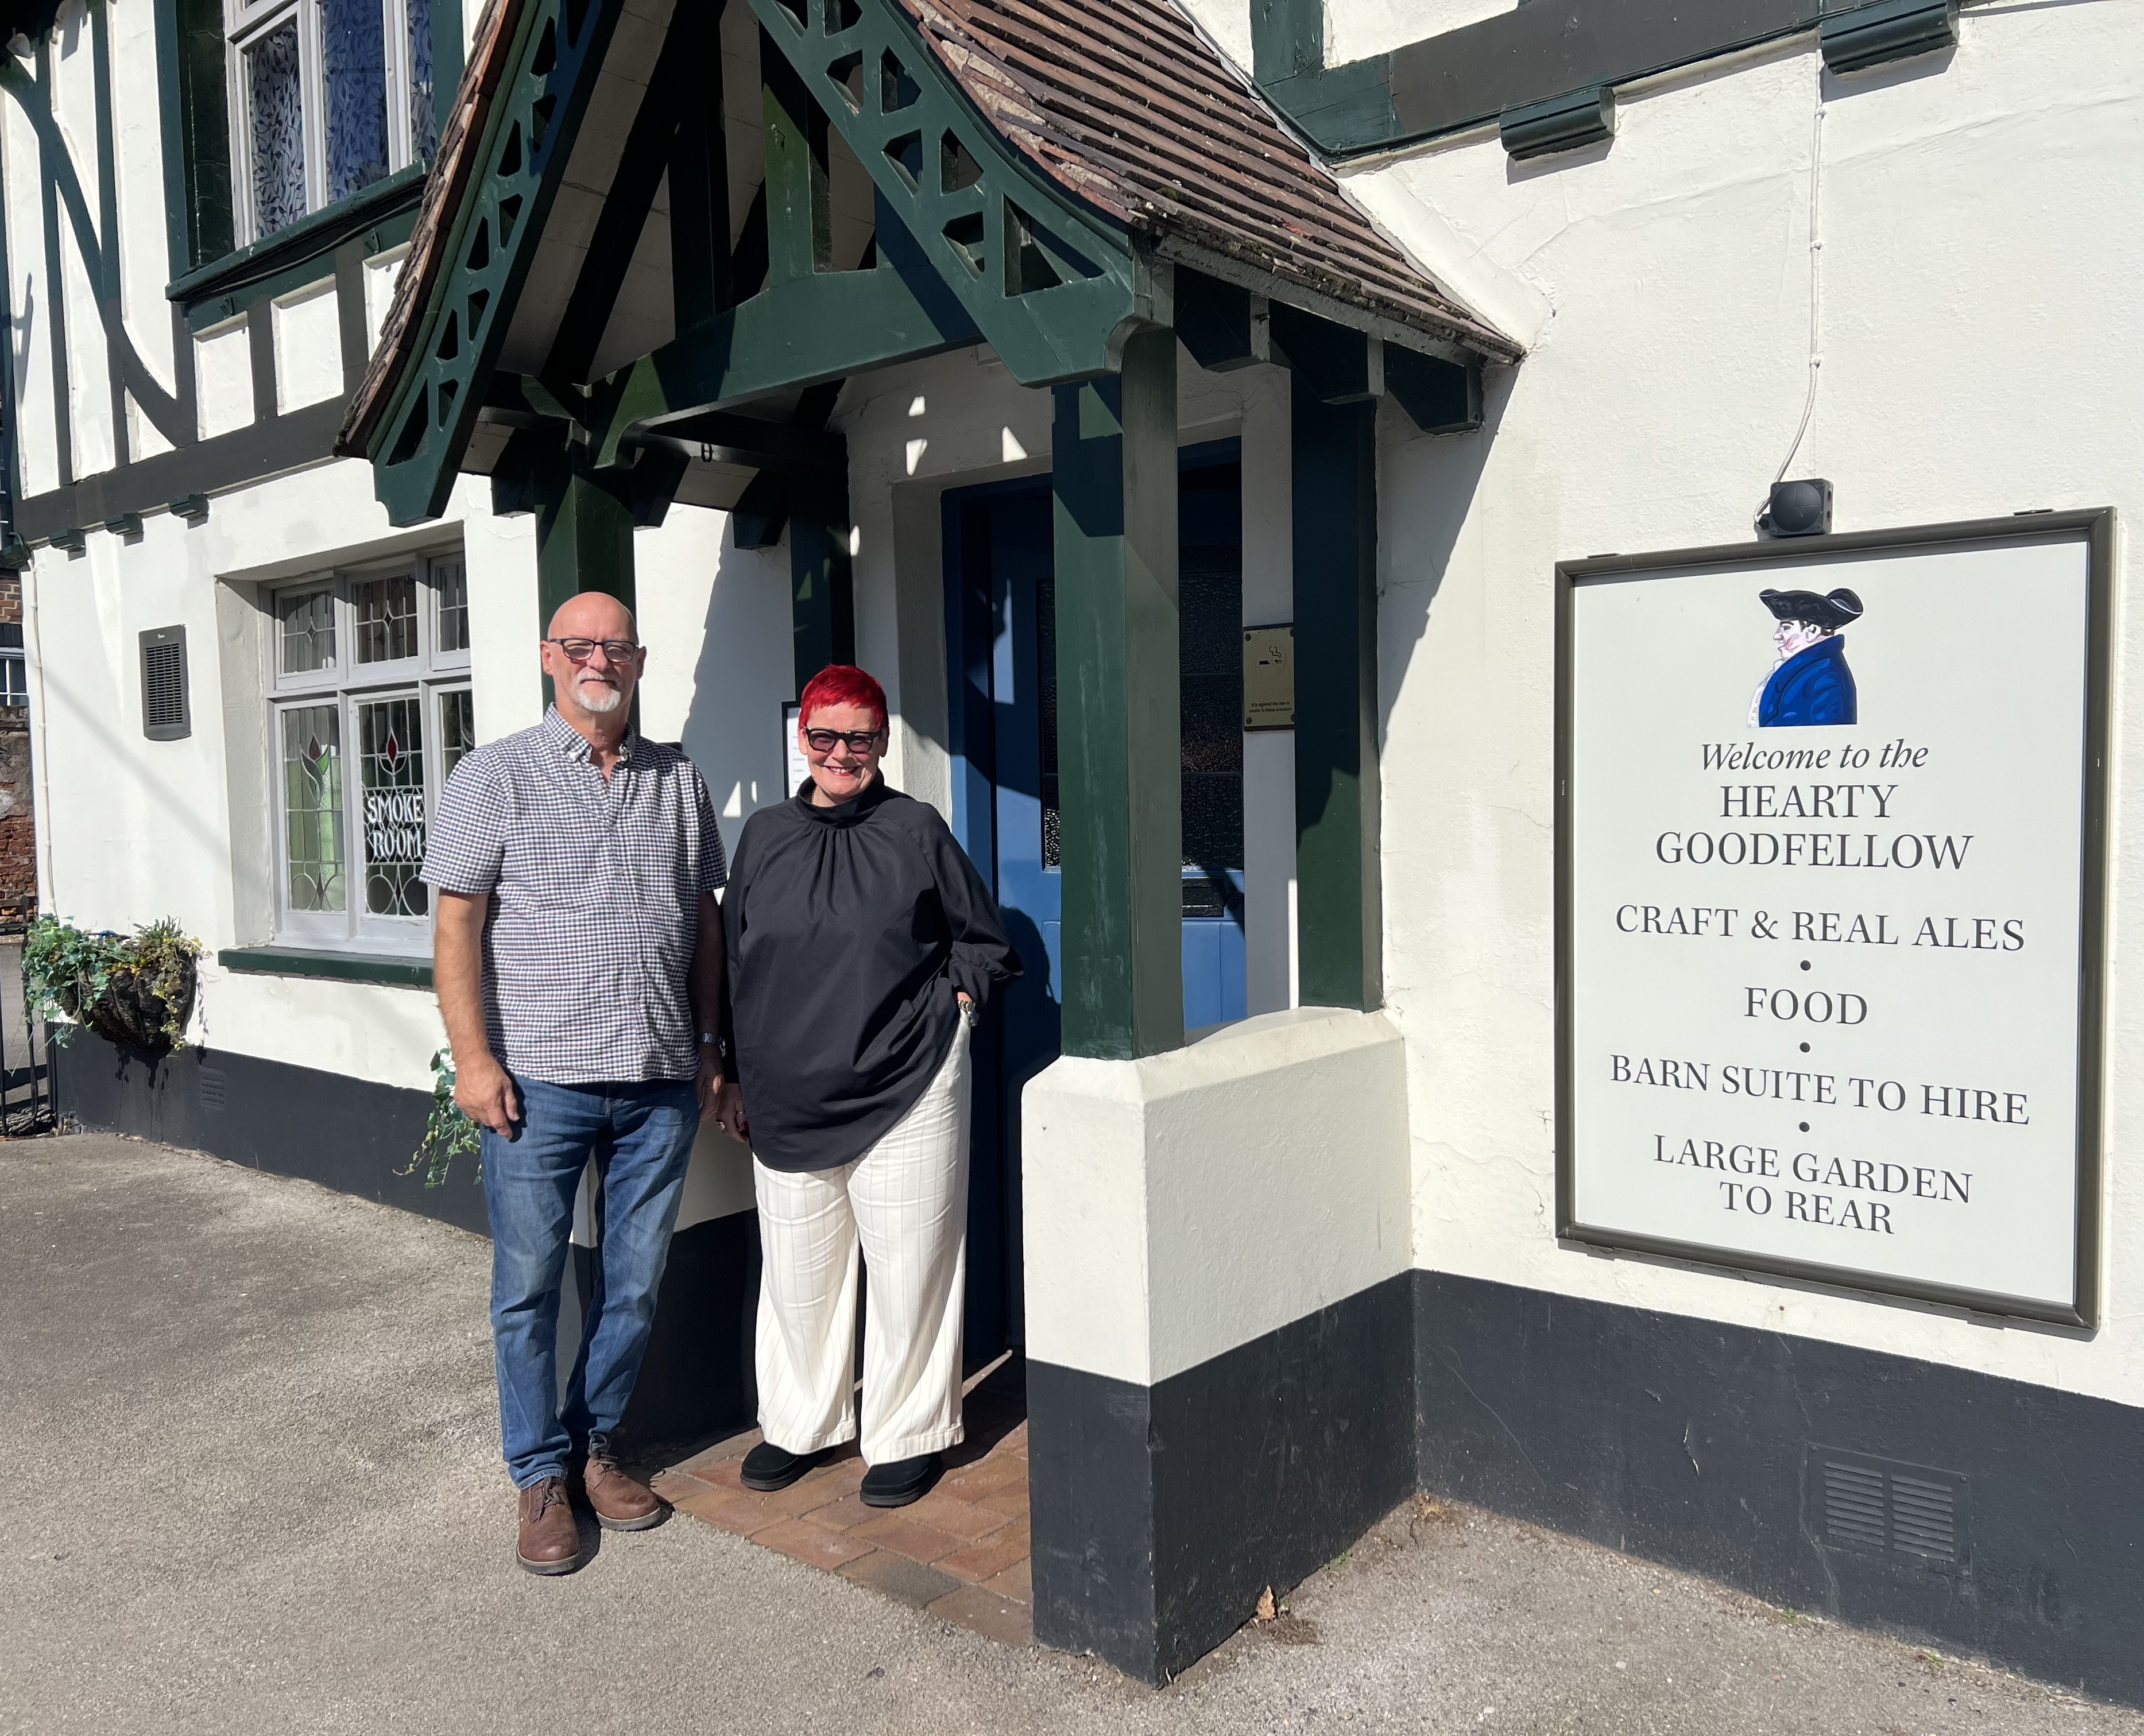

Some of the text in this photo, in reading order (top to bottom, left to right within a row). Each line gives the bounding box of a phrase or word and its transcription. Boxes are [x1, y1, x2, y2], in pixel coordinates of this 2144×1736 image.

[1701, 738, 1929, 770] Welcome to the
[367, 795, 424, 824] SMOKE
[1720, 784, 1898, 818] HEARTY
[373, 830, 421, 858] ROOM
[1656, 832, 1974, 870] GOODFELLOW
[1616, 905, 2024, 951] CRAFT & REAL ALES
[1744, 987, 1867, 1025] FOOD
[1611, 1054, 2029, 1125] BARN SUITE TO HIRE
[1654, 1134, 1973, 1203] LARGE GARDEN
[1720, 1181, 1894, 1234] TO REAR
